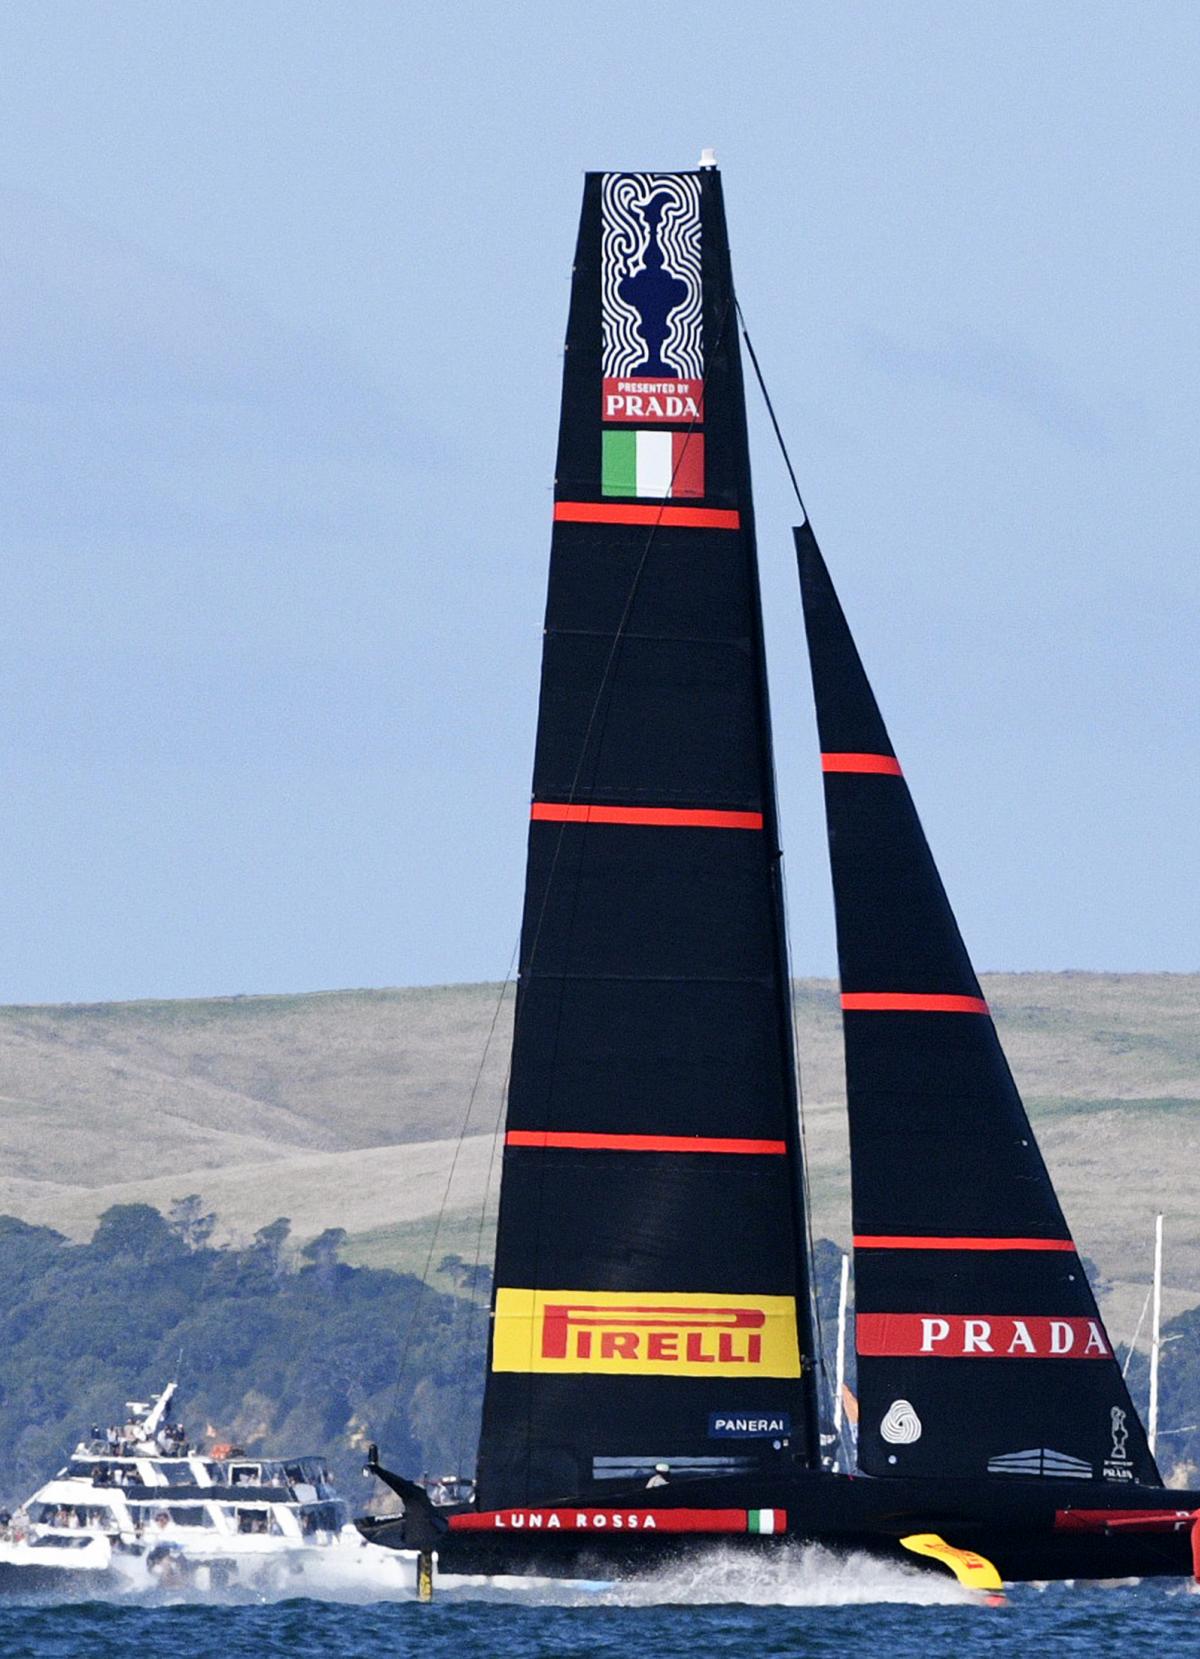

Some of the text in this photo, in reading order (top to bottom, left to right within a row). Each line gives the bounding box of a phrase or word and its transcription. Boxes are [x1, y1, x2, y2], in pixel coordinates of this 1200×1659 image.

[618, 382, 689, 393] PRESENTED BY
[606, 395, 700, 417] PRADA
[541, 1304, 766, 1363] PIRELLI
[920, 1318, 1109, 1354] PRADA
[715, 1419, 784, 1431] PANERAI
[494, 1514, 657, 1529] LUNA ROSSA
